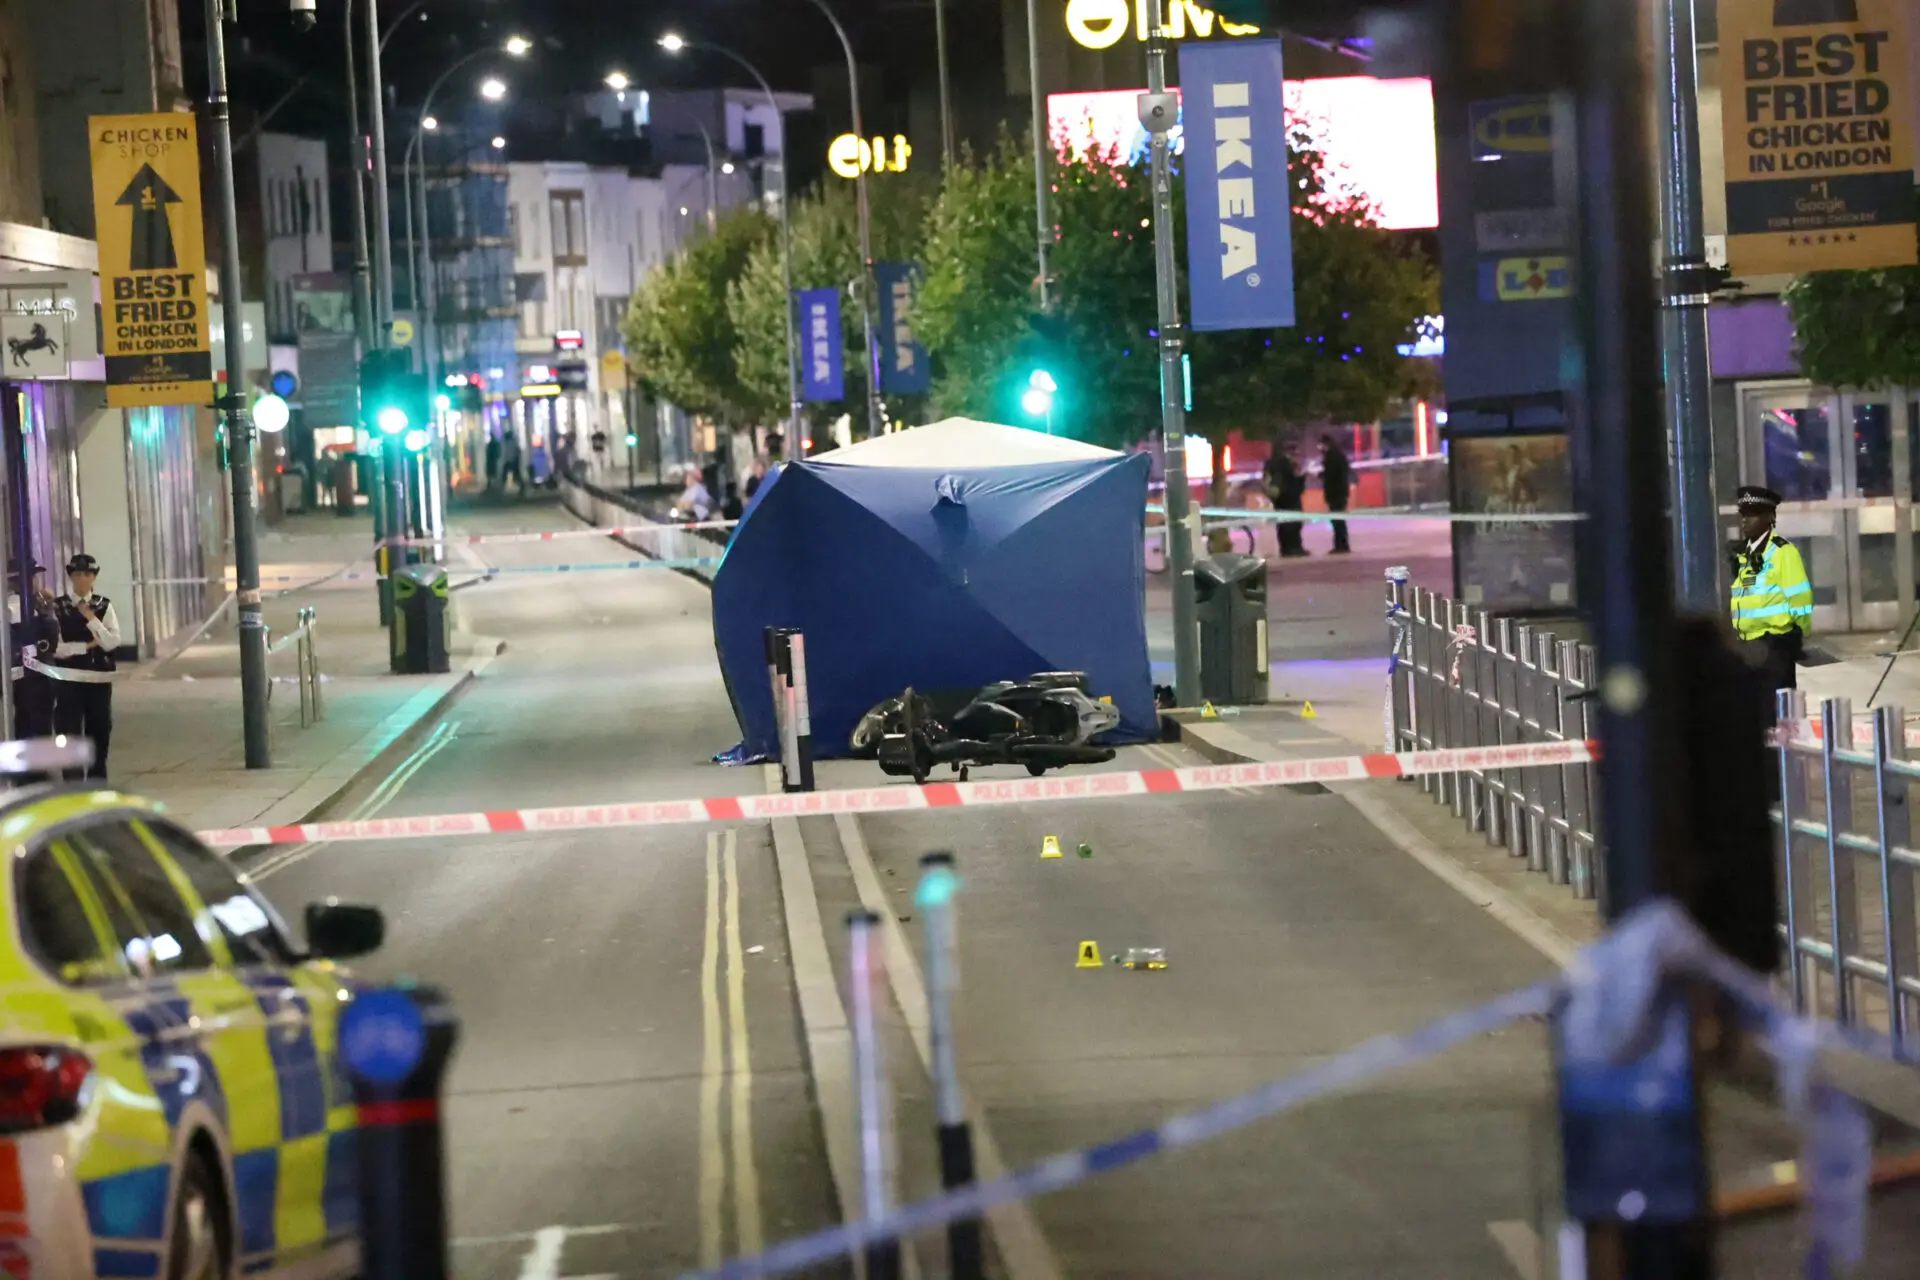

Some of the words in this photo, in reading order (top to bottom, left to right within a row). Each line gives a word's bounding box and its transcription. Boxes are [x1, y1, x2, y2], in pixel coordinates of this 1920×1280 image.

[1743, 31, 1889, 80] BEST
[1745, 79, 1889, 122] FRIED
[101, 127, 188, 143] CHICKEN
[1748, 119, 1890, 149] CHICKEN
[120, 143, 171, 158] SHOP
[1749, 154, 1776, 172] IN
[1781, 146, 1891, 171] LONDON
[1213, 82, 1258, 281] IKEA
[114, 273, 195, 300] BEST
[115, 300, 197, 323] FRIED
[117, 323, 197, 338] CHICKEN
[118, 341, 133, 351] IN
[137, 338, 197, 350] LONDON
[811, 304, 830, 382] IKEA
[1193, 768, 1233, 785] POLICE
[1236, 766, 1260, 782] LINE
[1284, 763, 1306, 779] NOT
[1310, 761, 1349, 777] CROSS
[974, 783, 1013, 799] POLICE
[1016, 781, 1041, 798] LINE
[1062, 778, 1086, 794] NOT
[1090, 775, 1130, 792] CROSS
[755, 799, 795, 814] POLICE
